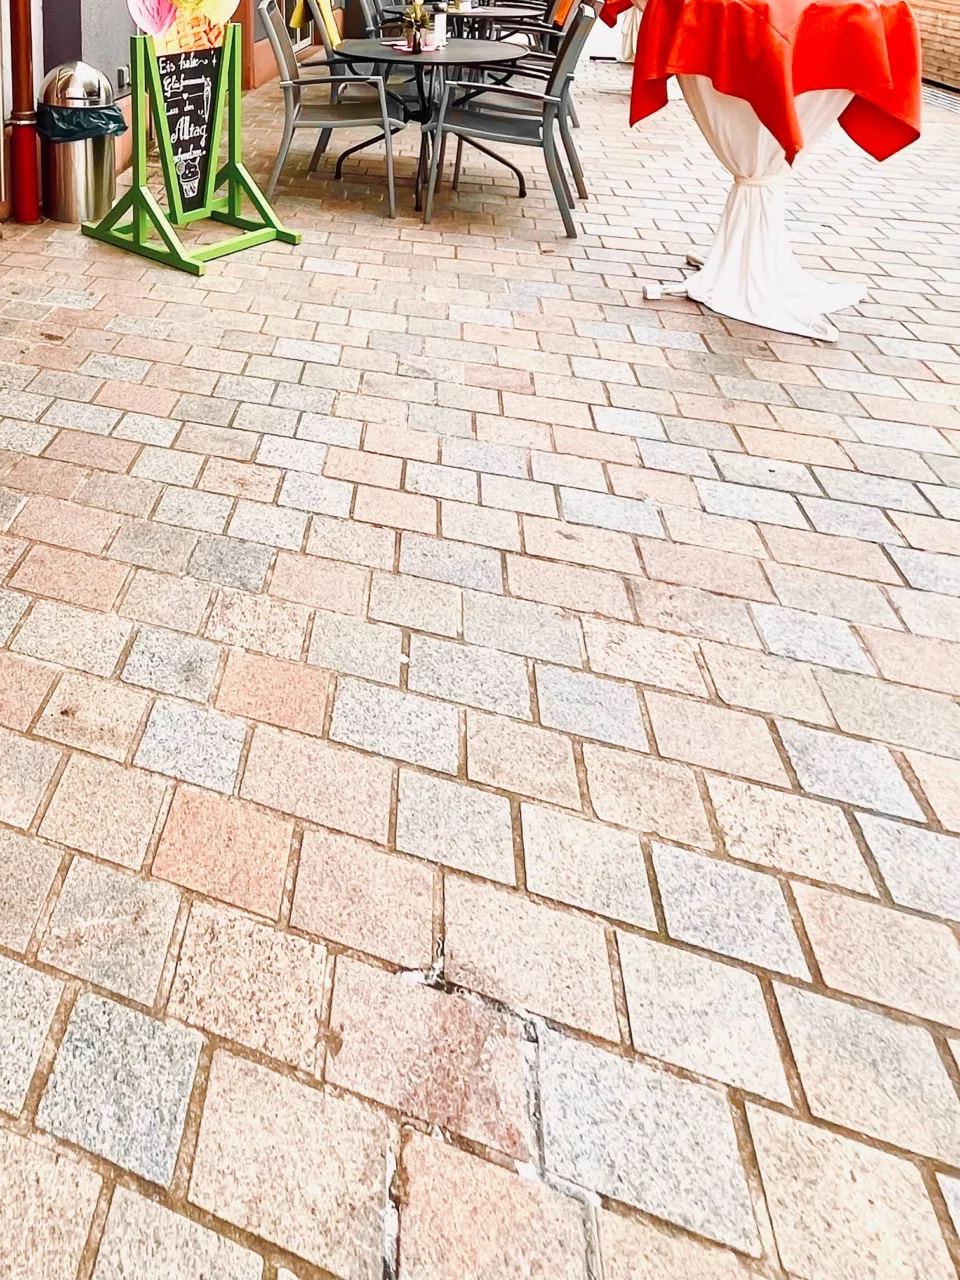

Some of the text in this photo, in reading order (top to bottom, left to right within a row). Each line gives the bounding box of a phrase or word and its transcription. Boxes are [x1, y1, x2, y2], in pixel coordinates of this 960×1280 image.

[159, 57, 176, 75] Eis
[163, 102, 179, 116] Lass
[170, 115, 208, 148] Alltag
